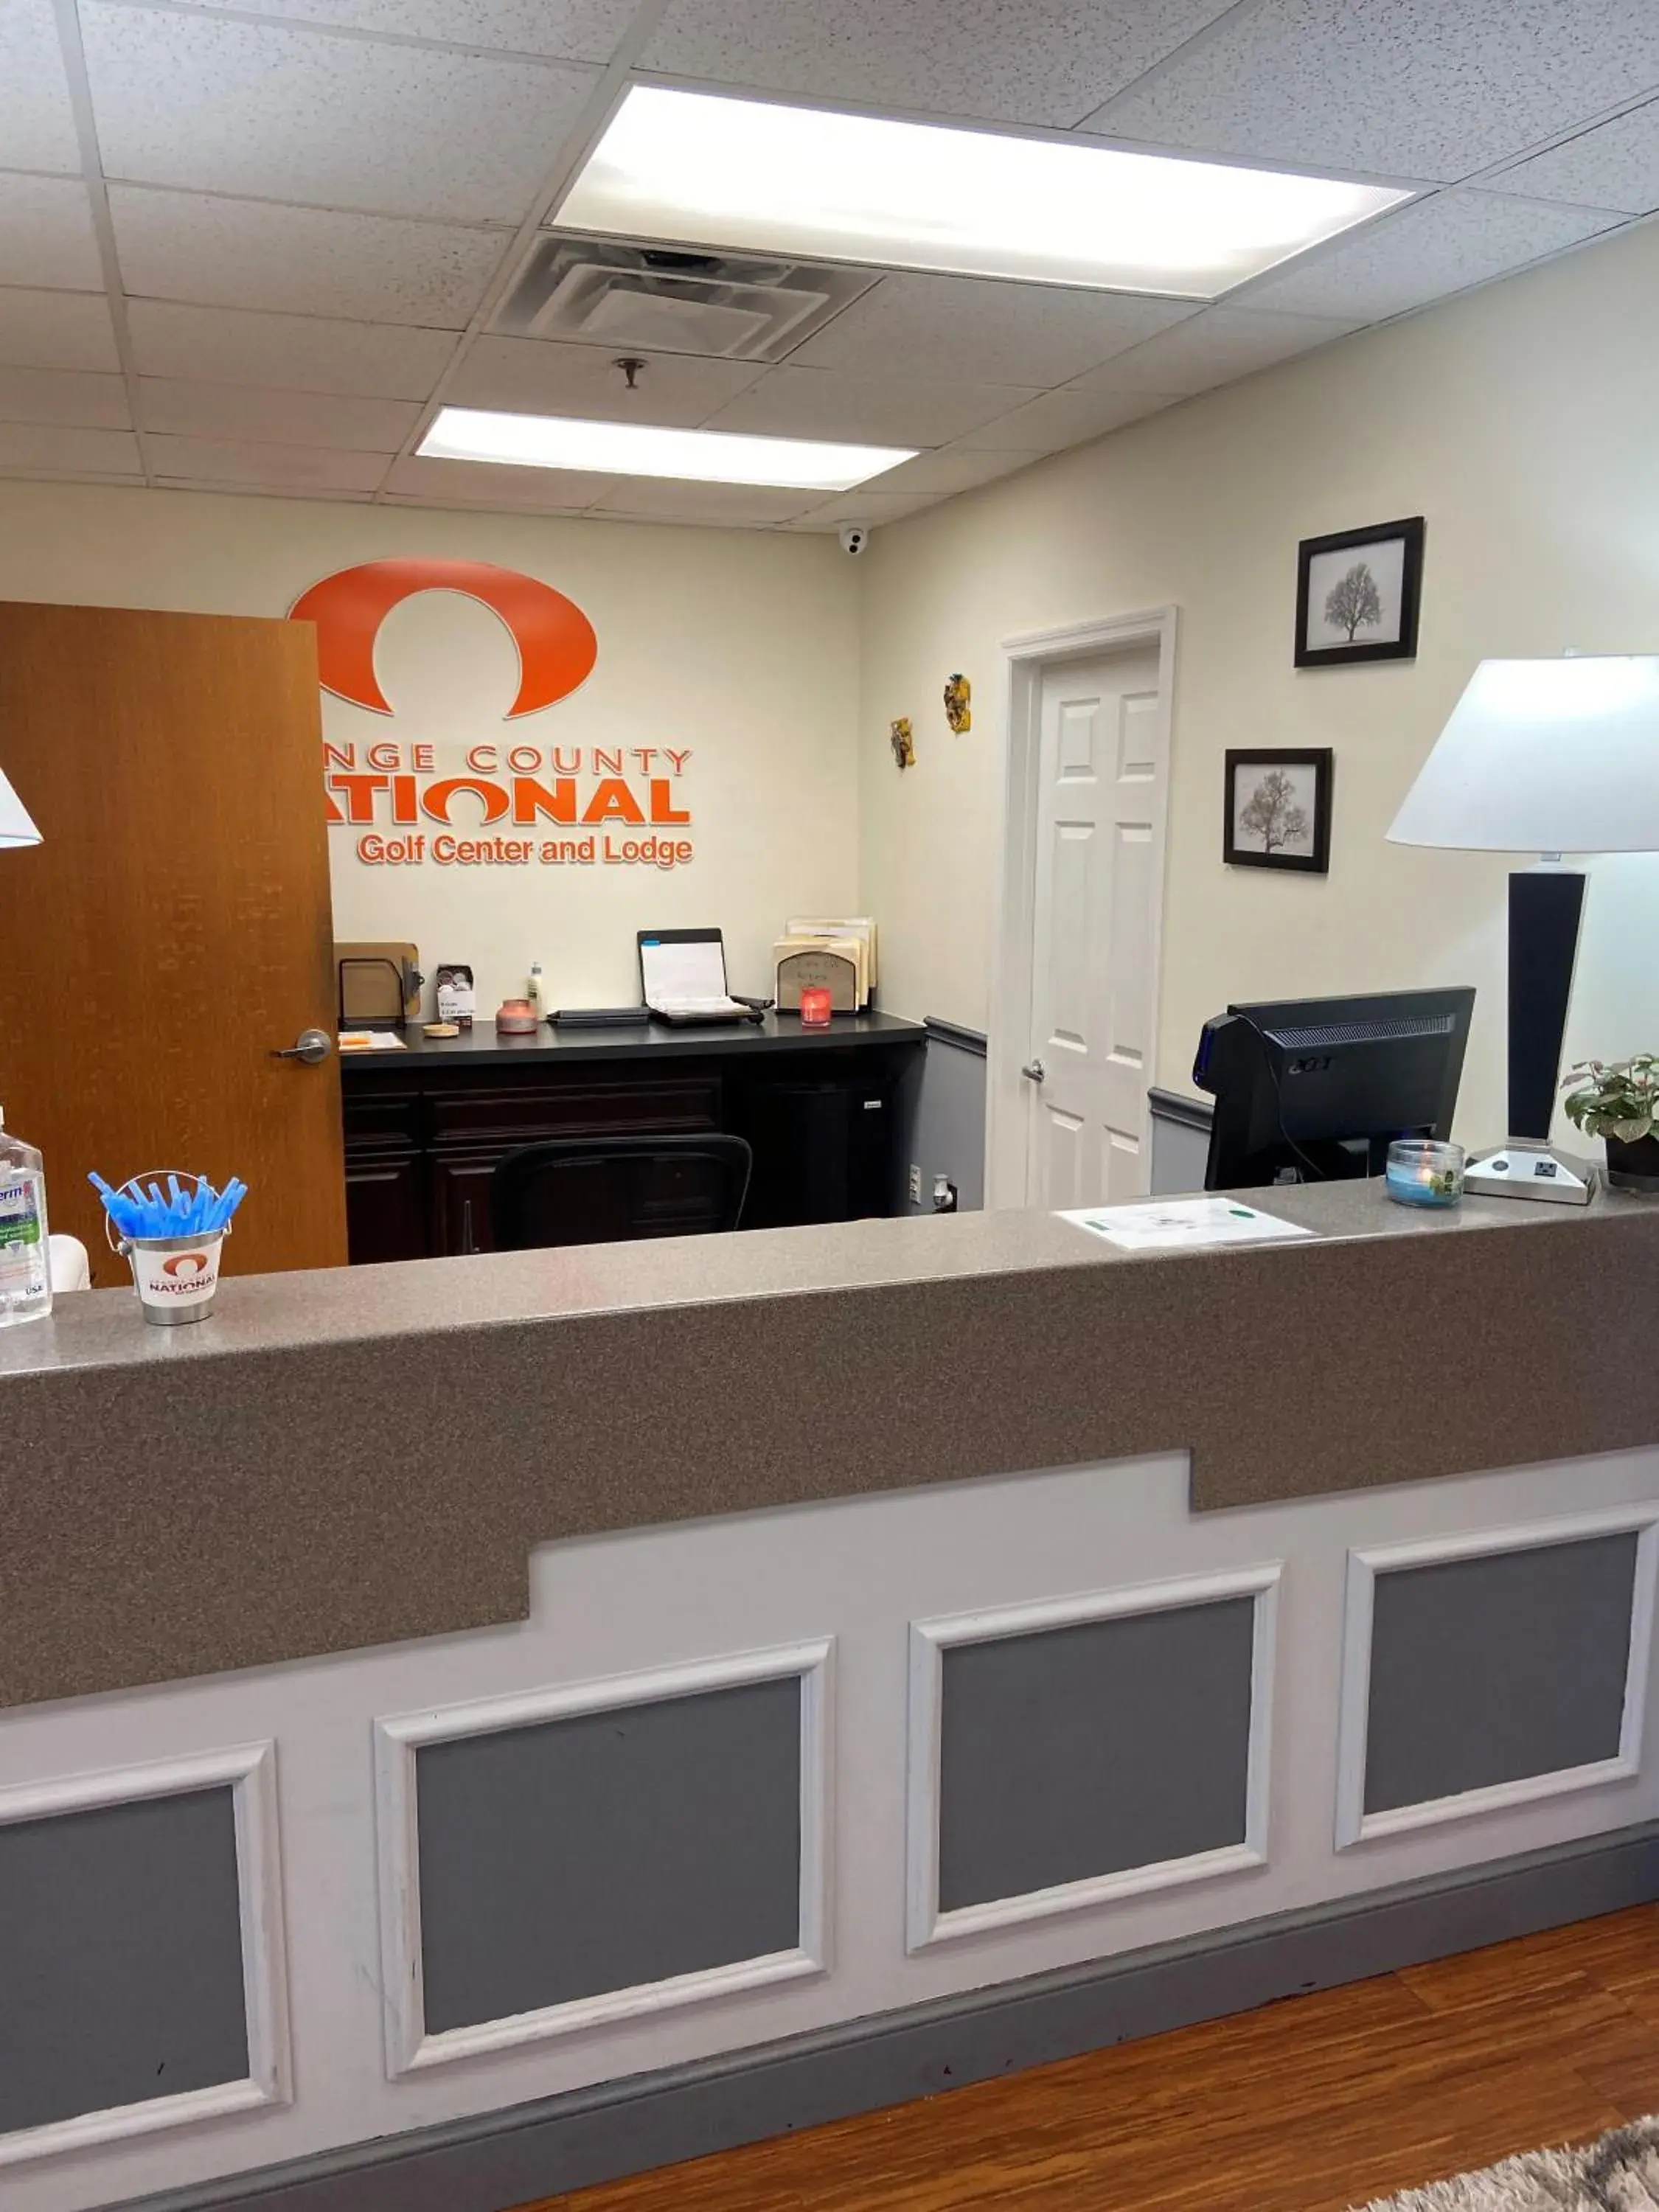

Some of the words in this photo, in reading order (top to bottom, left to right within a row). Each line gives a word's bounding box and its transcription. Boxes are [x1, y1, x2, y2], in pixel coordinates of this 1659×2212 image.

[467, 745, 693, 775] COUNTY
[357, 833, 426, 863] Golf
[432, 834, 533, 863] Center
[541, 835, 595, 862] and
[603, 835, 694, 868] Lodge
